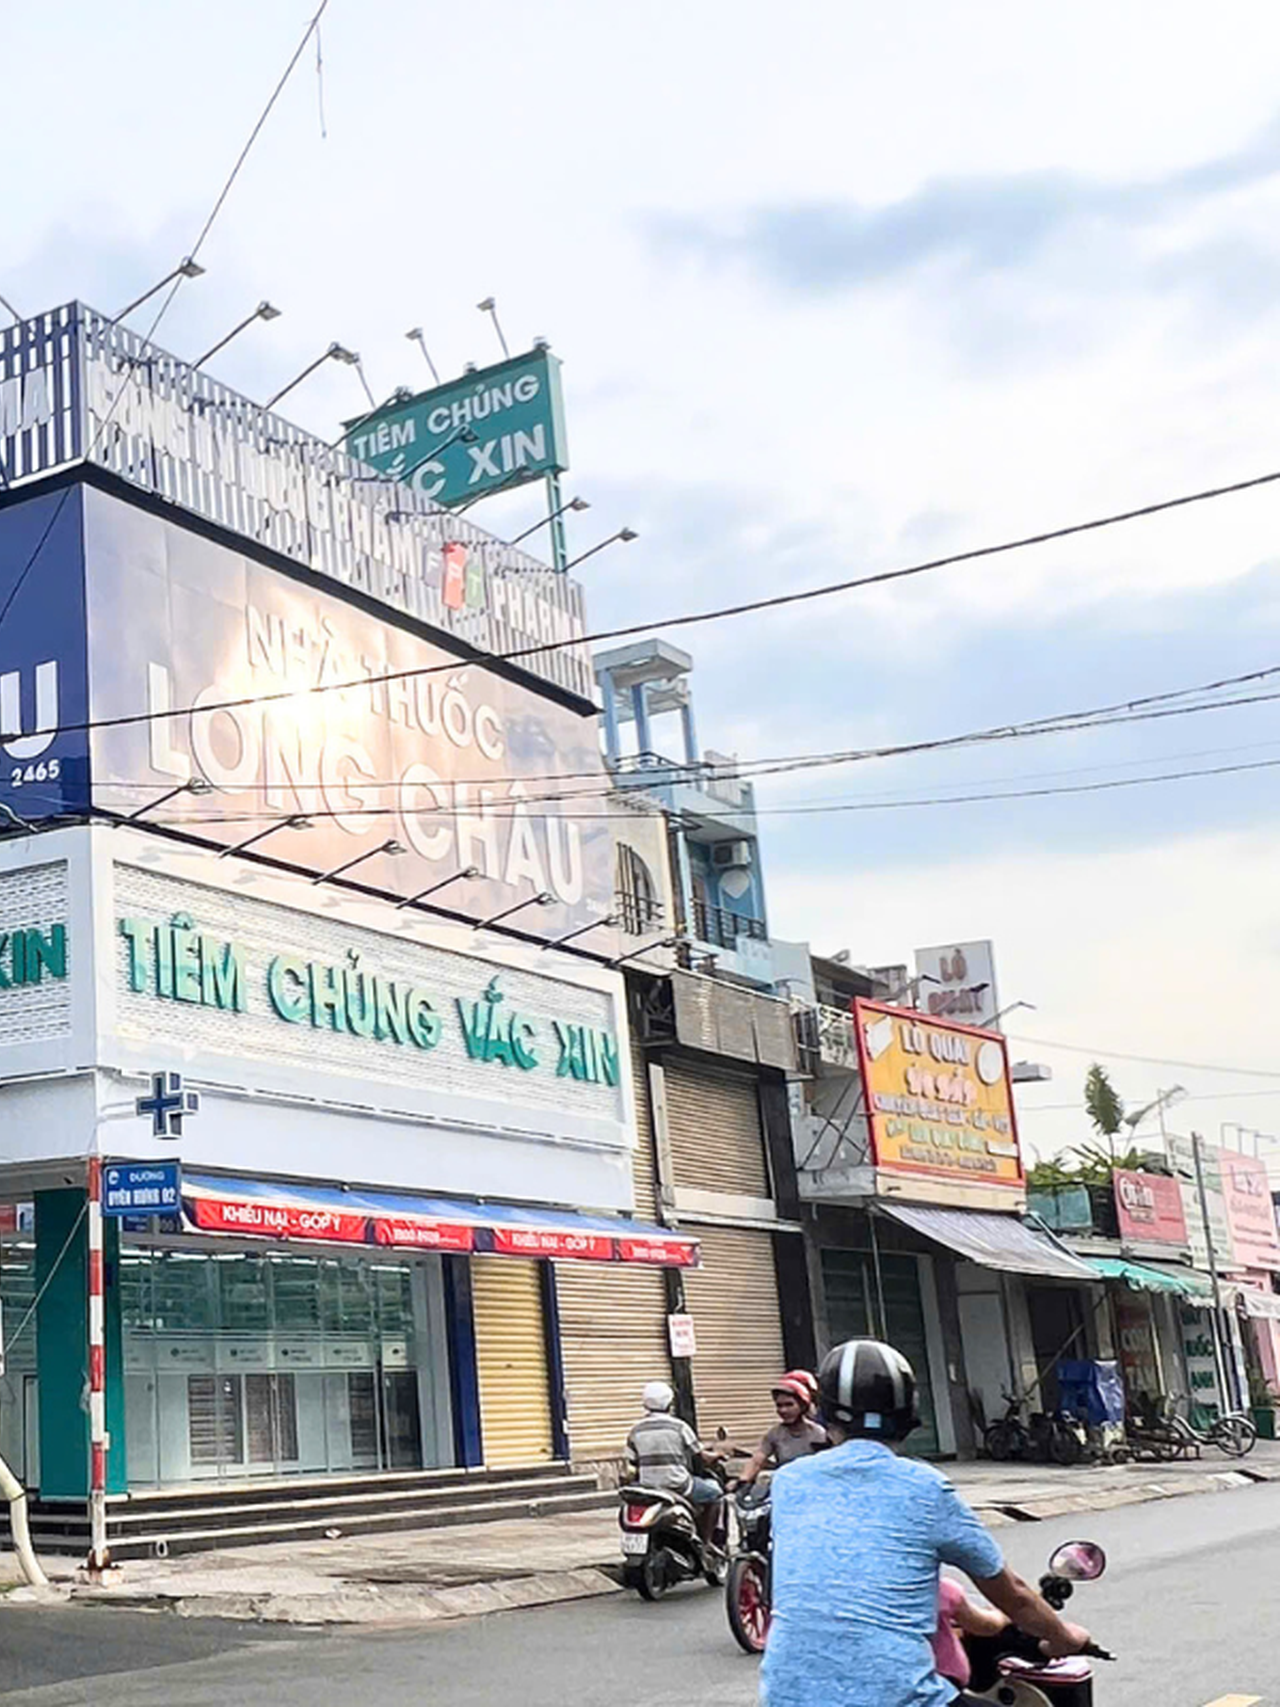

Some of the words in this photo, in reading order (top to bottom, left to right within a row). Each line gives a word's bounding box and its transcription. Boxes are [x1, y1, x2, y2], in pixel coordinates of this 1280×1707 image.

[353, 419, 417, 462] TIÊM
[426, 374, 540, 434] CHỦNG
[466, 424, 549, 484] XIN
[245, 603, 348, 690] NHÀ
[358, 675, 505, 762] THUỐC
[11, 759, 61, 788] 2465
[148, 660, 380, 836] LONG
[400, 763, 584, 906] CHÂU
[120, 911, 244, 1014] TIÊM
[268, 948, 442, 1051] CHỦNG
[457, 975, 539, 1070] VẮC
[552, 1020, 618, 1086] XIN
